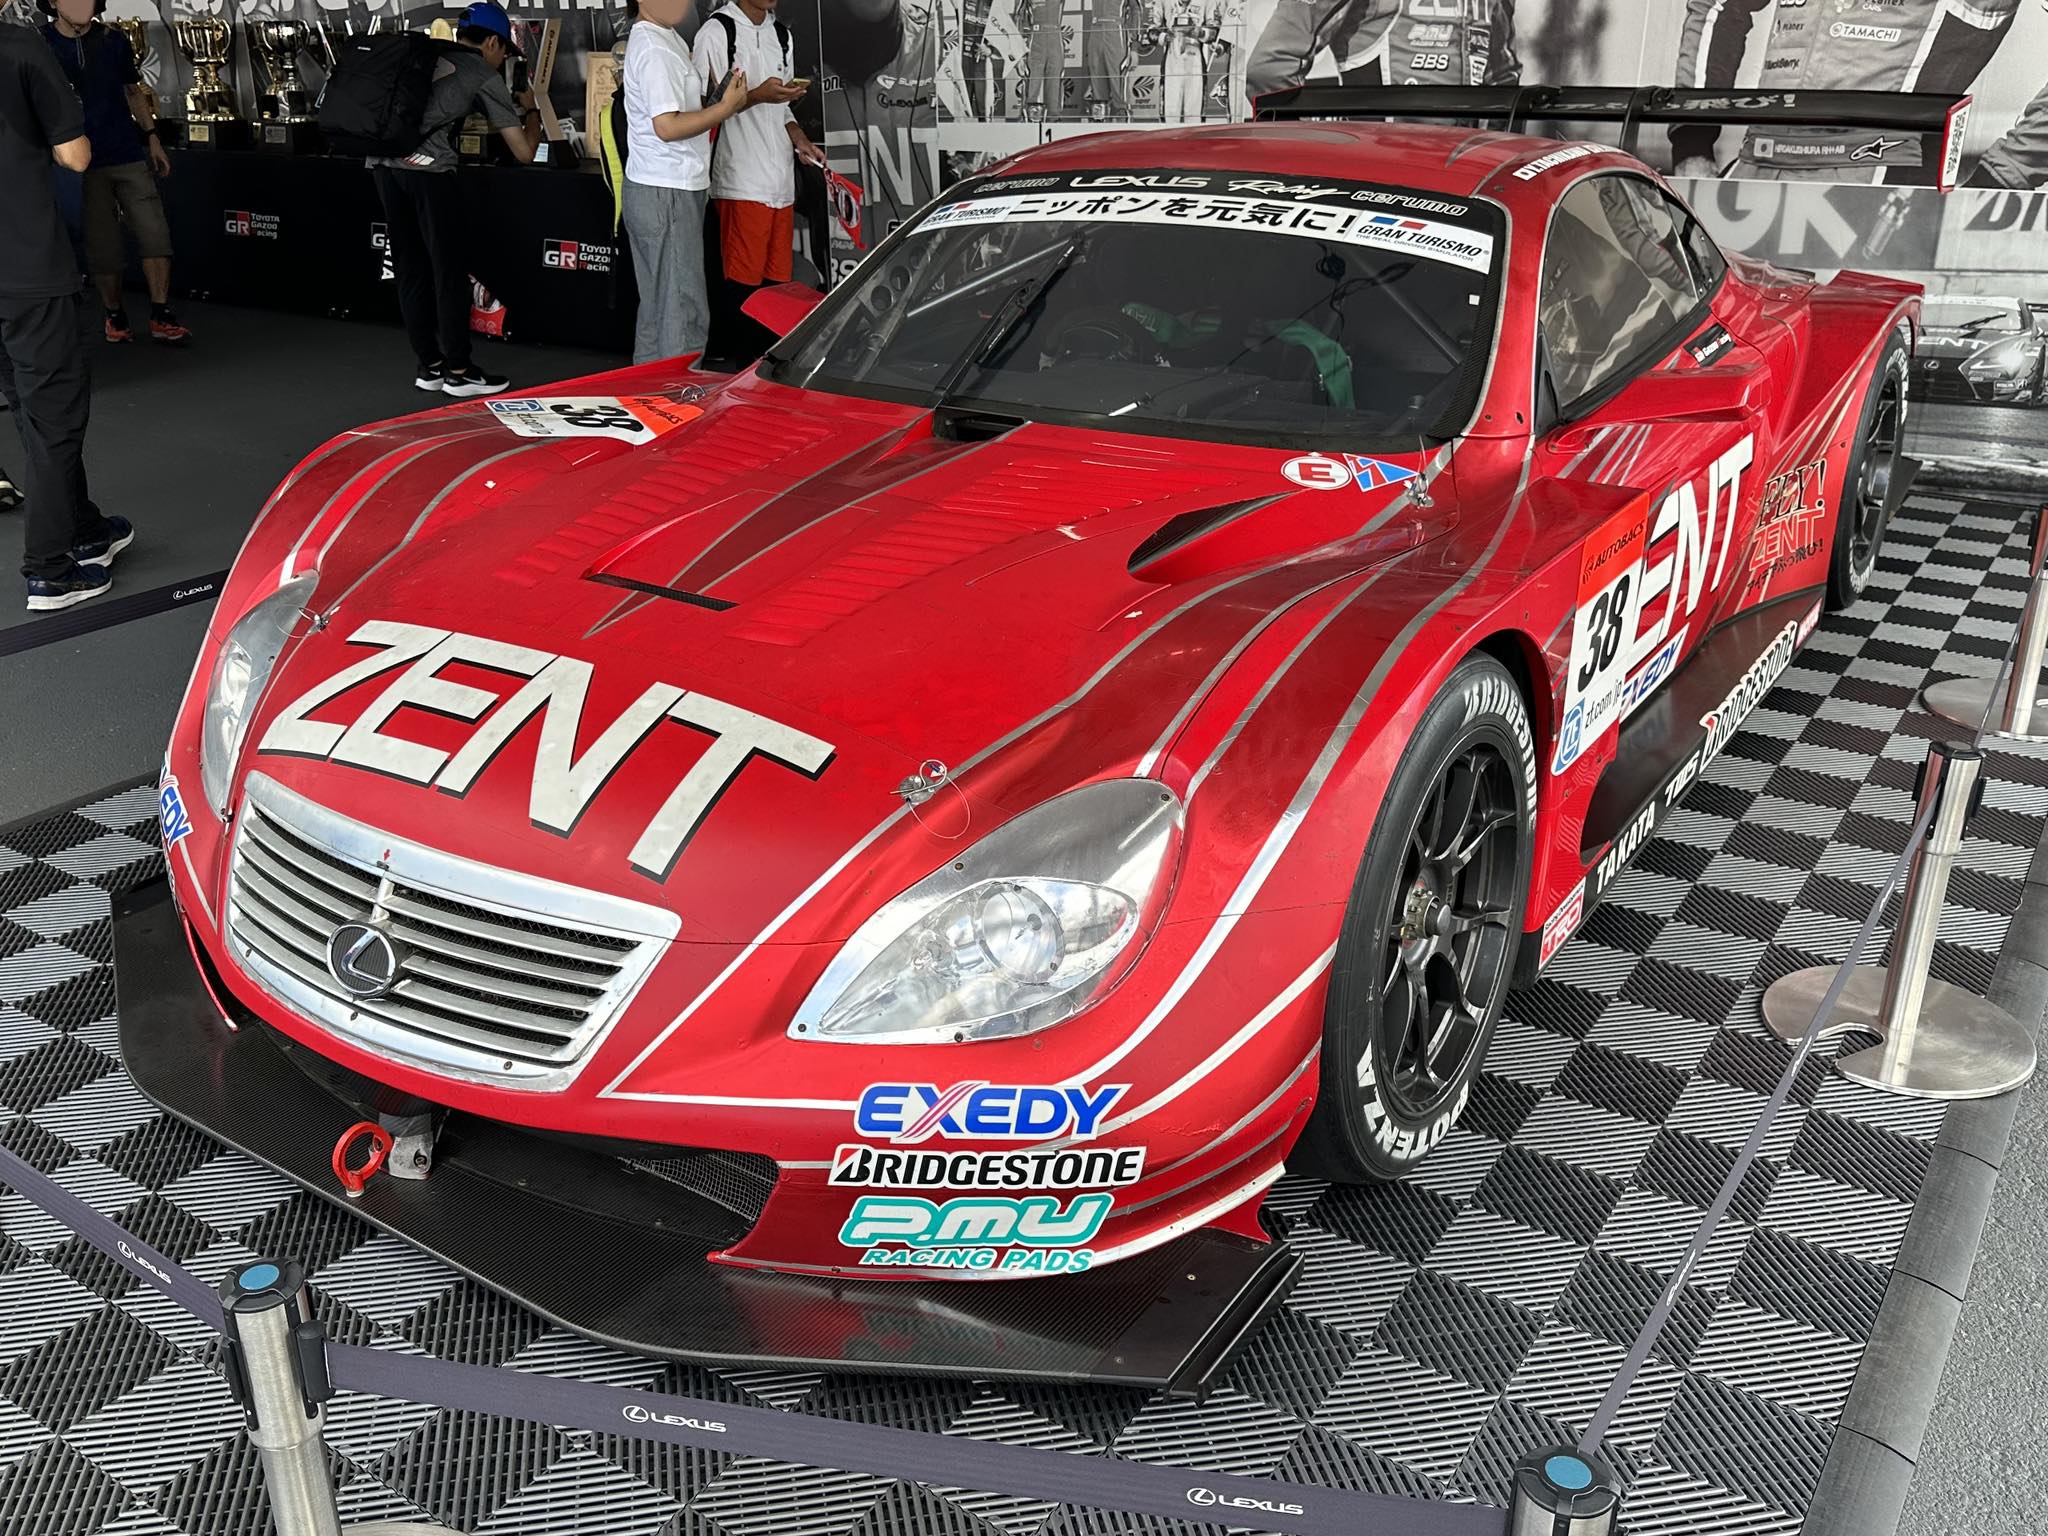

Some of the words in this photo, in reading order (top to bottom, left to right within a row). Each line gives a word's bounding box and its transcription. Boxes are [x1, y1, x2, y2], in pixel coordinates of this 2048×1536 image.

[1844, 26, 1898, 40] TAMACHI
[1410, 53, 1449, 70] BBS
[1069, 176, 1212, 188] LEXUS
[1350, 190, 1468, 217] cerumo
[226, 220, 250, 235] GR
[251, 213, 280, 223] TOYOTA
[251, 221, 278, 230] GAZOO
[1008, 194, 1356, 234] ニッポンを元気に!
[579, 252, 611, 263] GAZO
[1357, 225, 1403, 239] GRAN
[1407, 232, 1482, 257] TURISMO
[1371, 234, 1389, 242] REAL
[1390, 239, 1426, 251] DRIVING
[1427, 245, 1474, 262] SIMULATOR
[545, 250, 577, 267] GR
[579, 261, 610, 272] Racin
[1917, 336, 1989, 350] ENT
[1757, 458, 1827, 529] FLY!
[1593, 519, 1645, 571] AUTOBACS
[1634, 433, 1754, 660] ENT
[1749, 507, 1826, 572] ZENT
[183, 583, 213, 596] LEXUS
[1577, 574, 1631, 692] 38
[1621, 632, 1675, 716] EXEDY
[1699, 621, 1798, 774] BRIDGESTONE
[257, 619, 837, 885] ZENT
[1454, 676, 1537, 832] BRIDGESTONE
[1596, 801, 1656, 894] TAKATA
[857, 1082, 1126, 1140] EXEDY
[1357, 1039, 1470, 1160] POTENZA
[833, 1147, 1141, 1186] BRIDGESTONE
[131, 1252, 172, 1285] LEXUS
[863, 1250, 994, 1270] RACING
[1002, 1250, 1093, 1273] PADS
[650, 1412, 727, 1433] LEXUS
[1218, 1495, 1304, 1516] LEXUS
